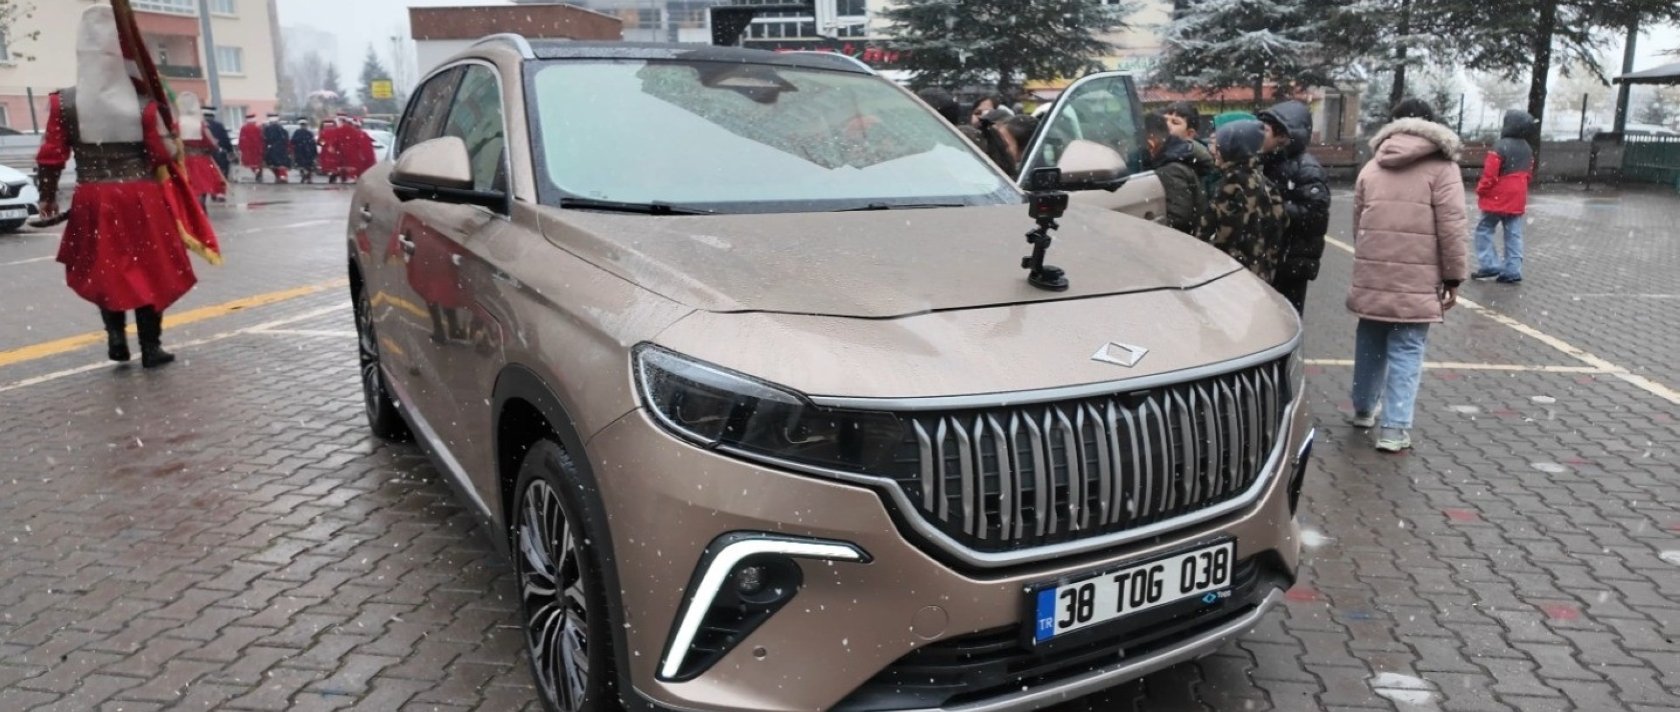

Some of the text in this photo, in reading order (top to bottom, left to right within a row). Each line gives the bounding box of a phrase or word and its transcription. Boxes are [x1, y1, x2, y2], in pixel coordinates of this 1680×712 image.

[1058, 547, 1229, 628] 38 TOG 038
[1039, 617, 1053, 630] TR
